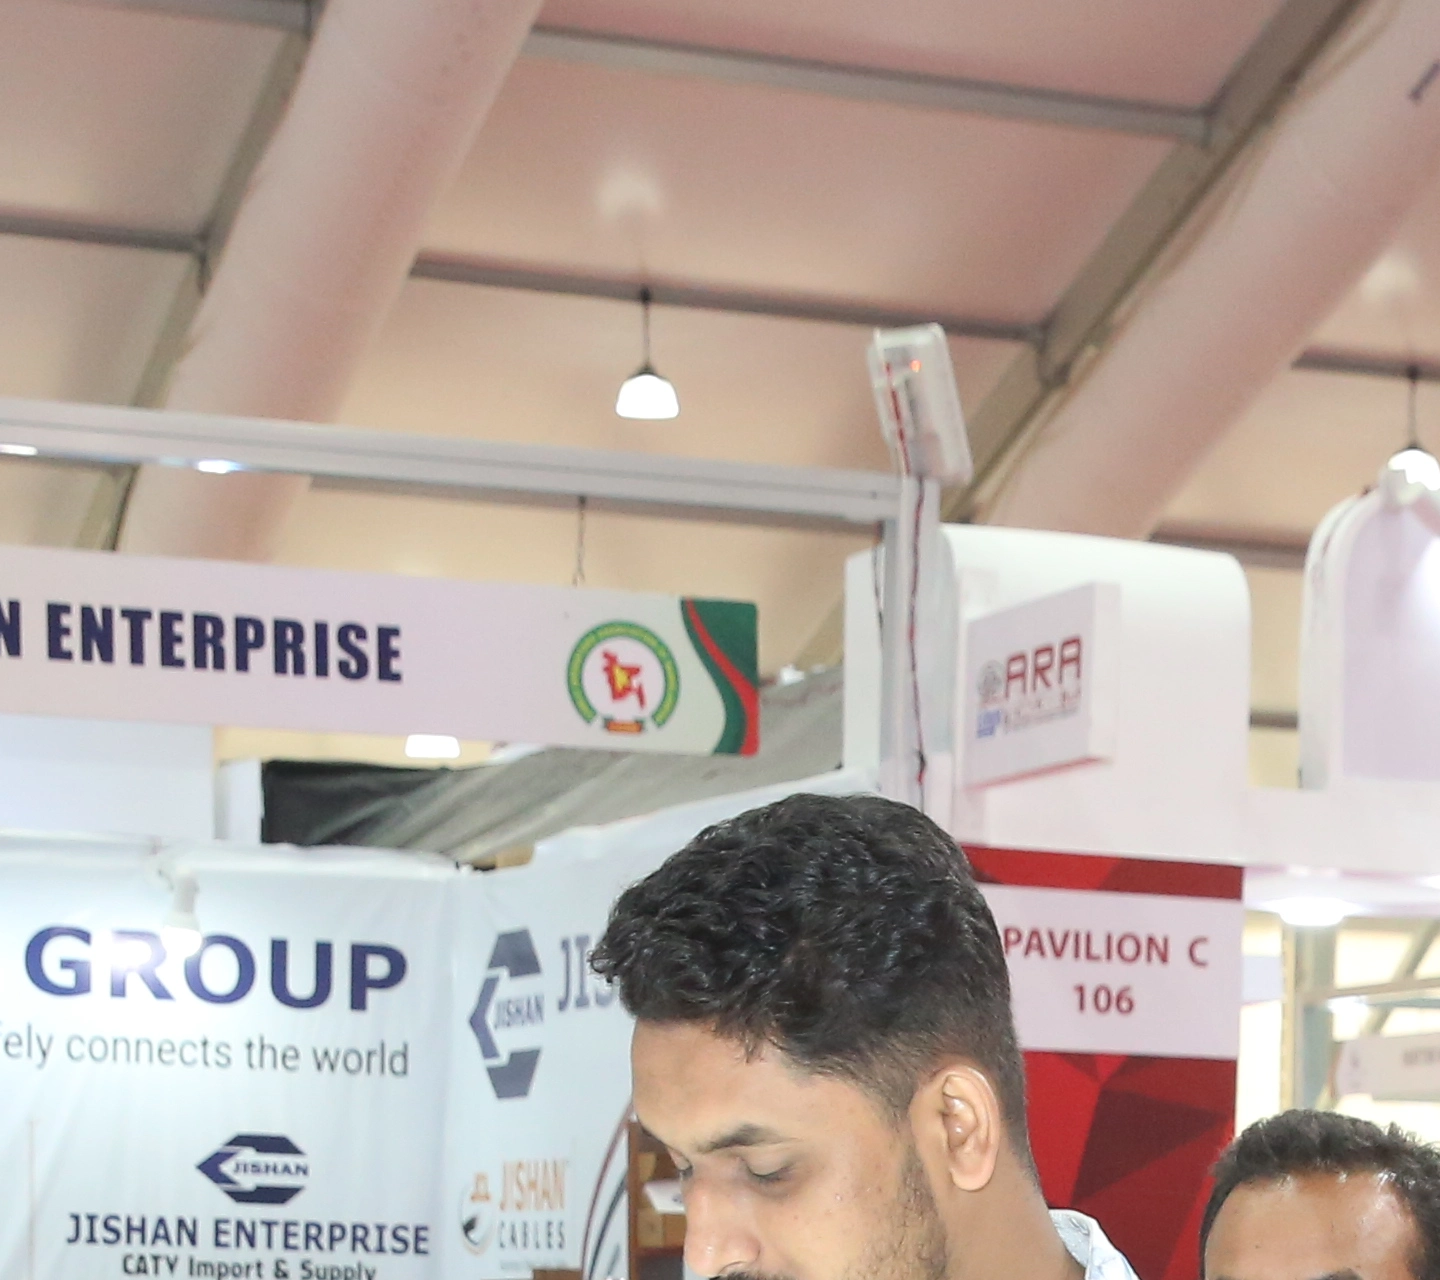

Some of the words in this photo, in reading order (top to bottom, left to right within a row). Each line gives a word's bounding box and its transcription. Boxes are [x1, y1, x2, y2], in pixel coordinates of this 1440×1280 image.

[47, 602, 403, 684] ENTERPRISE
[1005, 636, 1082, 698] ARA
[23, 926, 408, 1012] GROUP
[1003, 927, 1170, 964] PAVILION
[1188, 936, 1210, 967] C
[1074, 984, 1136, 1014] 106
[66, 1031, 232, 1070] connects
[245, 1036, 300, 1071] the
[312, 1041, 409, 1077] world
[233, 1162, 308, 1177] JISHAN
[499, 1158, 567, 1212] JISHAN
[66, 1213, 198, 1247] JISHAN
[213, 1218, 431, 1255] ENTERPRISE
[274, 1259, 291, 1280] &
